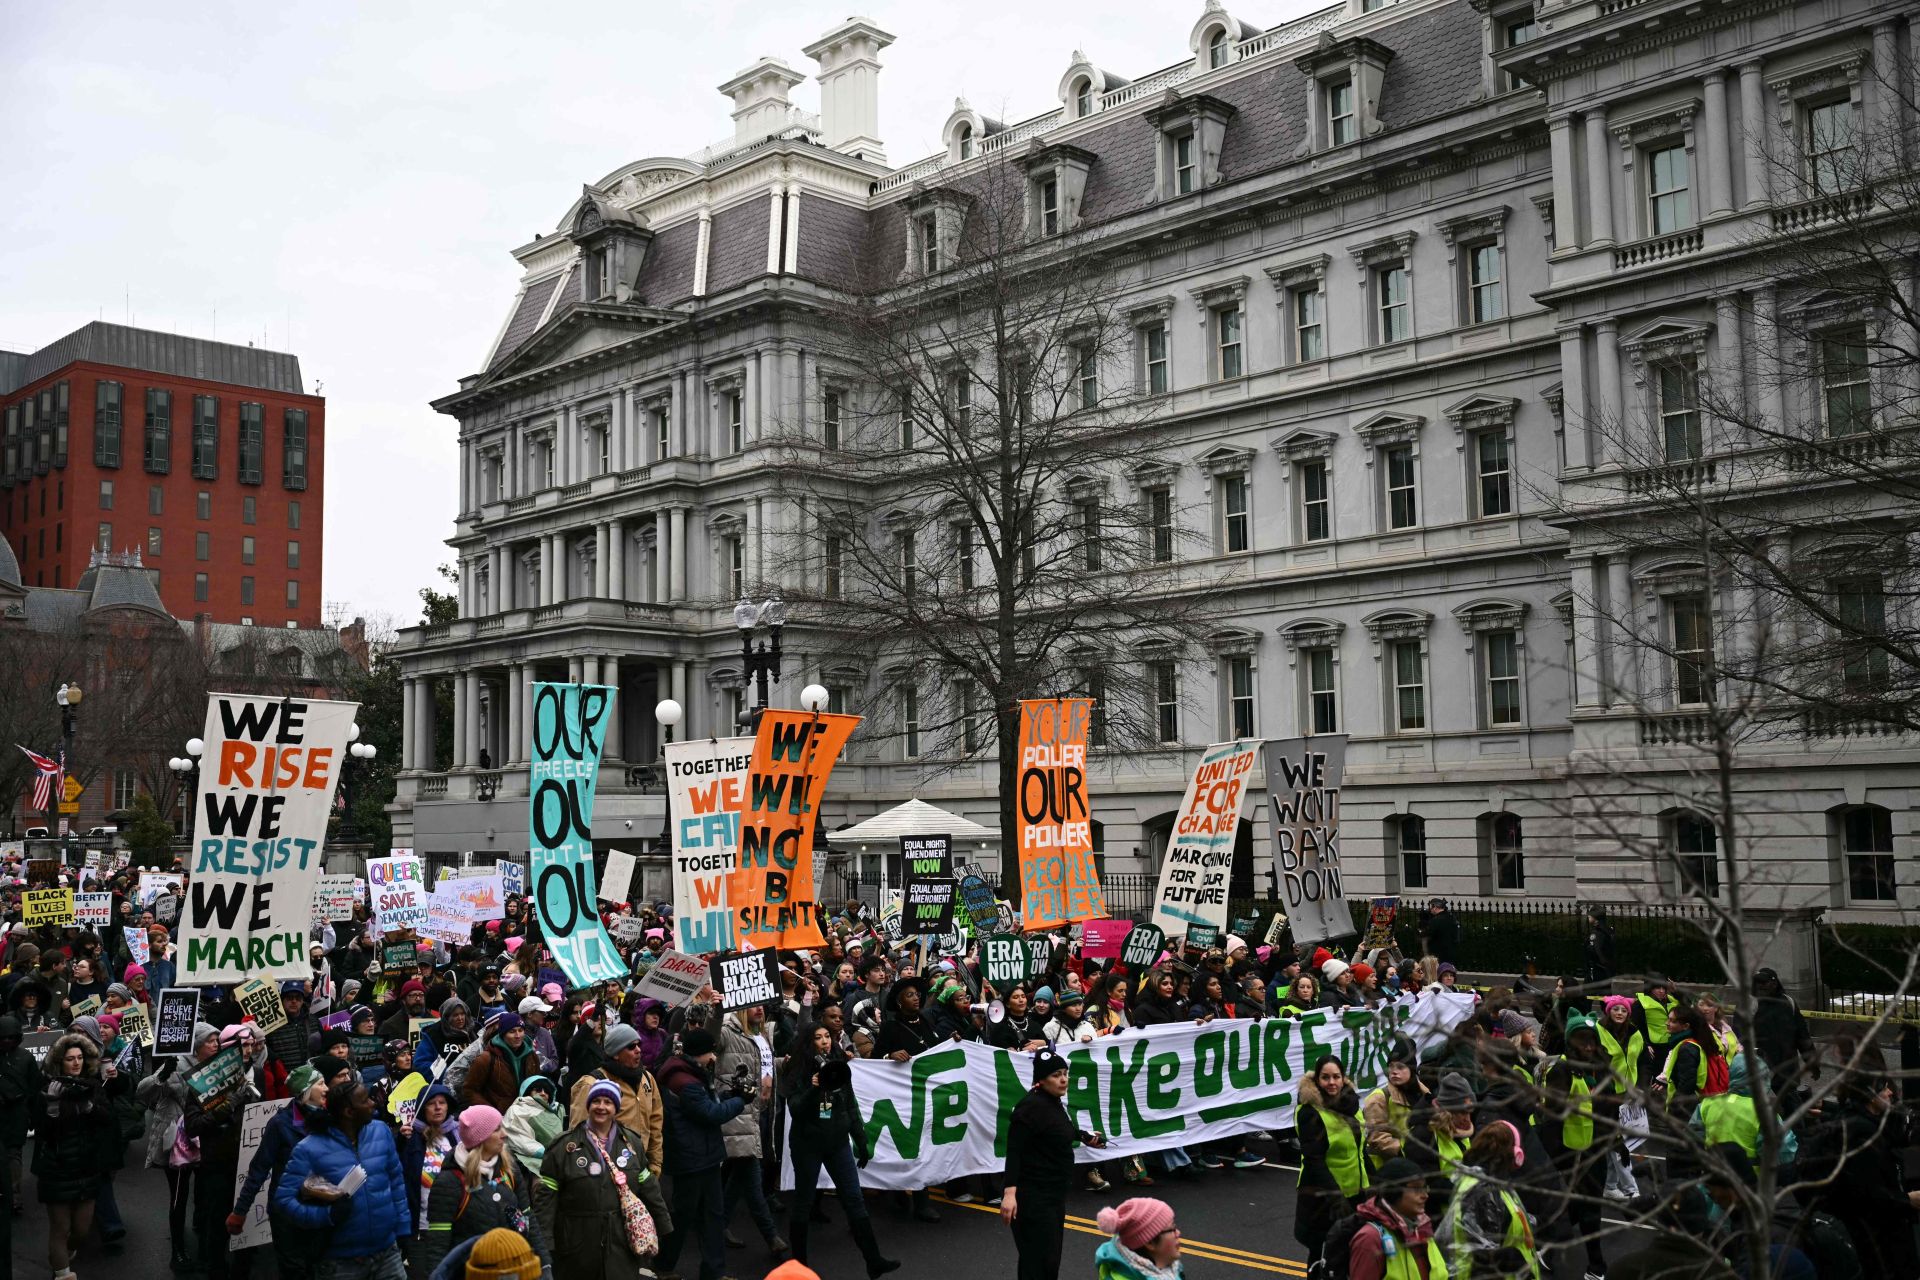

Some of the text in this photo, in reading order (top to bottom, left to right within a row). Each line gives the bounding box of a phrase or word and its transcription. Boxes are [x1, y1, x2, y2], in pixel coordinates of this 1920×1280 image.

[219, 700, 307, 744] WE
[533, 685, 607, 761] OUR
[1024, 701, 1089, 746] YOUR
[218, 741, 333, 789] RISE
[1195, 752, 1254, 785] UNITED
[1280, 752, 1327, 789] WE
[688, 778, 743, 814] WE
[1021, 767, 1087, 825] OUR
[1190, 778, 1241, 815] FOR
[205, 792, 285, 839] WE
[532, 778, 592, 850] OU
[530, 843, 593, 866] FUTU
[904, 840, 946, 849] EQUAL RIGHTS
[905, 849, 946, 859] AMENDMENT
[1279, 827, 1338, 871] BAK
[196, 837, 316, 876] RESIST
[678, 853, 736, 872] TOGET
[913, 859, 940, 873] NOW
[1170, 847, 1231, 868] MARCHING
[371, 862, 421, 886] QUEER
[503, 862, 519, 877] NO
[1023, 850, 1099, 892] PEOPLE
[1170, 869, 1224, 886] FOR OUR
[28, 889, 67, 901] BLACK
[386, 884, 395, 892] as
[910, 884, 931, 894] EQUAL
[932, 884, 951, 893] RIGHTS
[1163, 886, 1225, 905] FUTURE
[31, 901, 65, 914] LIVES
[192, 882, 273, 931] WE
[380, 892, 417, 911] SAVE
[537, 862, 597, 938] OU
[909, 894, 950, 903] AMENDMENT
[25, 914, 72, 926] MATTER
[74, 908, 109, 916] USTICE
[740, 901, 813, 935] SILENT
[916, 905, 943, 919] NOW
[999, 905, 1009, 917] RA
[387, 944, 414, 953] PEOPLE
[940, 936, 957, 949] NOW
[1129, 928, 1160, 949] ERA
[187, 932, 304, 971] MARCH
[987, 940, 1024, 962] ERA
[1123, 947, 1156, 966] NOW
[384, 960, 417, 970] POLITICS
[661, 957, 708, 976] DARE
[720, 953, 765, 977] TRUST
[988, 961, 1024, 981] NOW
[1030, 958, 1049, 974] OW
[723, 968, 768, 993] BLACK
[722, 983, 779, 1009] WOMEN.
[163, 1005, 192, 1013] BELIEVE
[173, 1012, 191, 1021] STILL
[160, 1027, 189, 1035] PROTEST
[172, 1034, 190, 1042] SHIT
[192, 1047, 240, 1082] PEOPLE
[1194, 1020, 1292, 1097] OUR
[205, 1062, 240, 1085] OVER
[245, 1105, 261, 1121] IT
[230, 1236, 249, 1249] EAT
